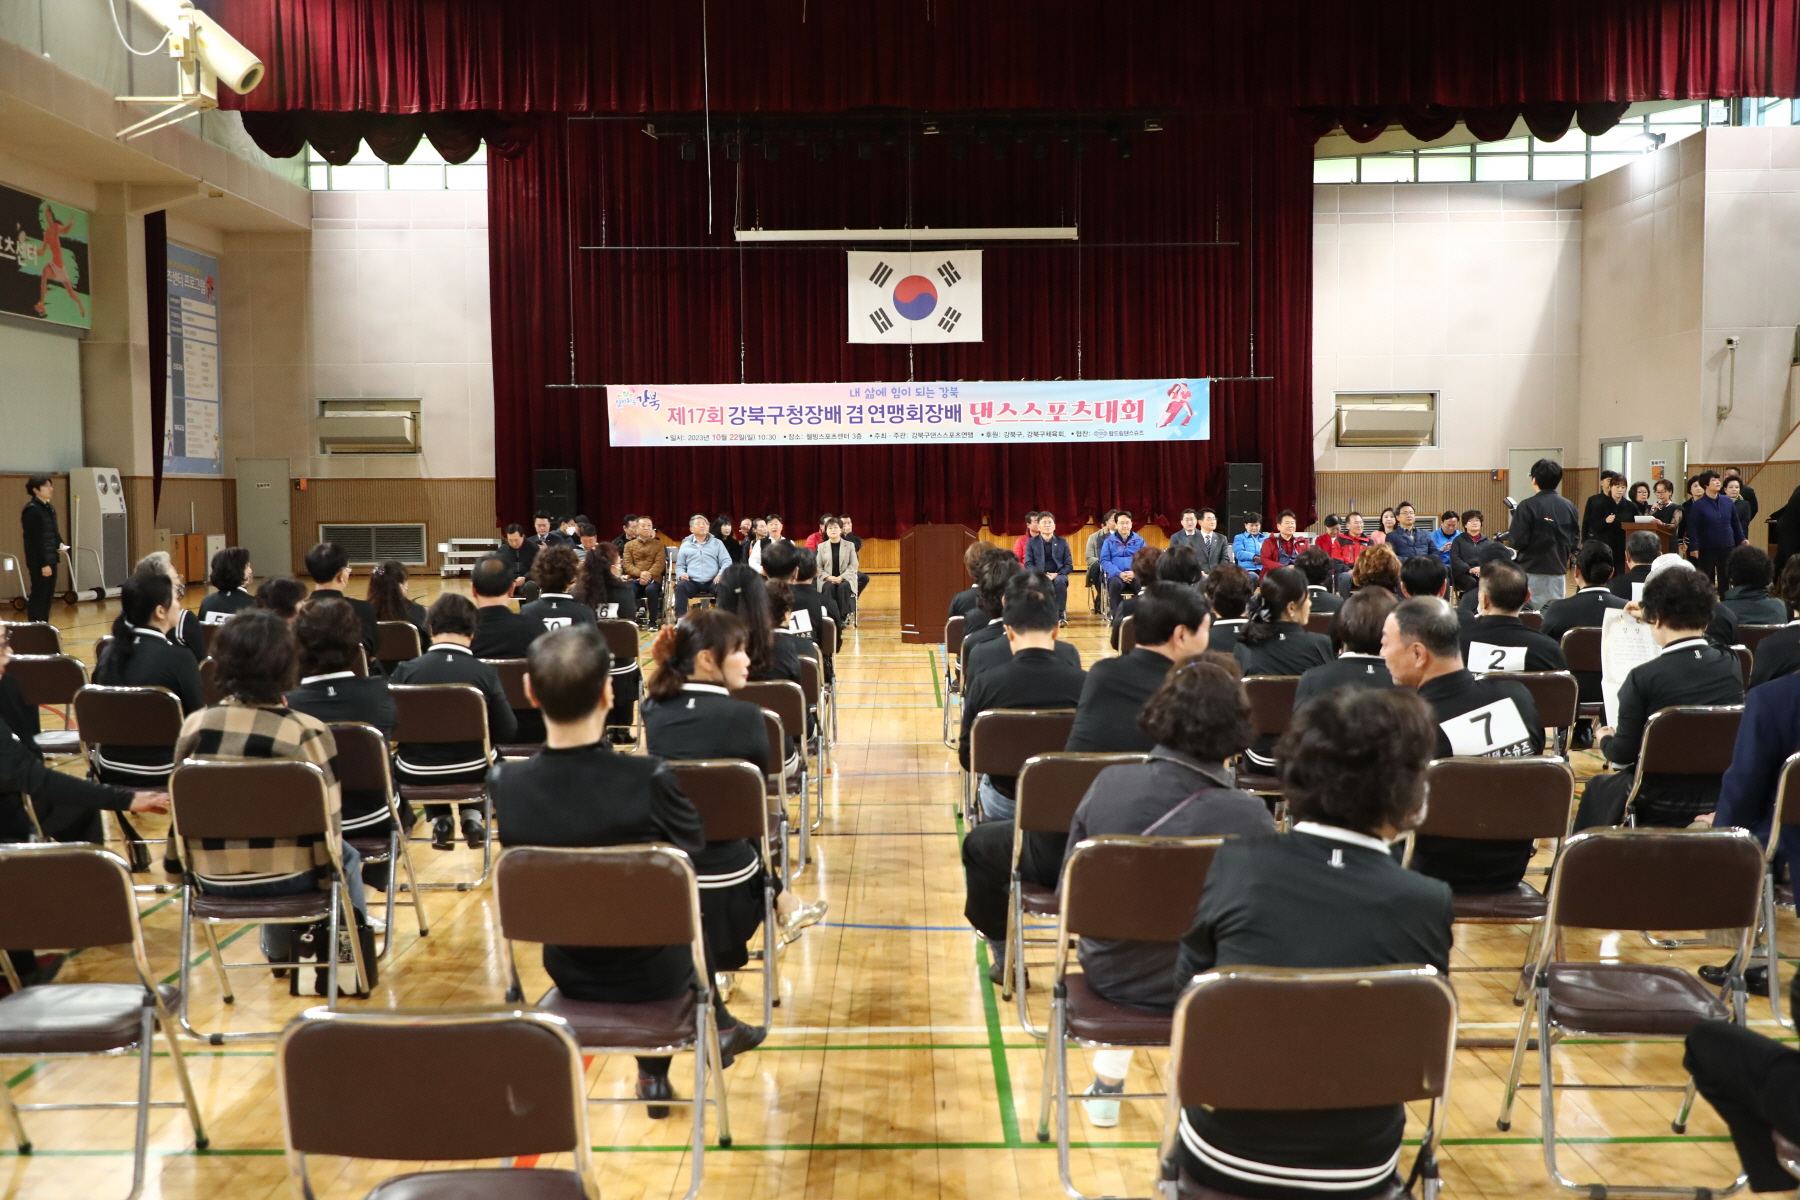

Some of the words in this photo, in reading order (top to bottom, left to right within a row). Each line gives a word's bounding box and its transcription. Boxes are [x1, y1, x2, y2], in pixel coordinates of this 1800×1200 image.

[0, 235, 38, 266] 츠센터
[184, 274, 206, 295] 프로그램
[637, 389, 660, 411] 강북
[849, 387, 860, 397] 내
[864, 387, 887, 399] 삶에
[891, 387, 911, 399] 힘이
[915, 387, 935, 399] 되는
[939, 387, 959, 399] 강북
[667, 406, 724, 425] 제17회
[728, 405, 842, 425] 강북구청장배
[846, 405, 863, 424] 겸
[867, 403, 962, 424] 연맹회장배
[969, 399, 1144, 426] 댄스스포츠대회
[806, 433, 850, 441] 웰빙스포츠센터
[911, 431, 974, 439] 강북구댄스스포츠연맹
[1488, 649, 1506, 670] 2
[1469, 711, 1493, 746] 7
